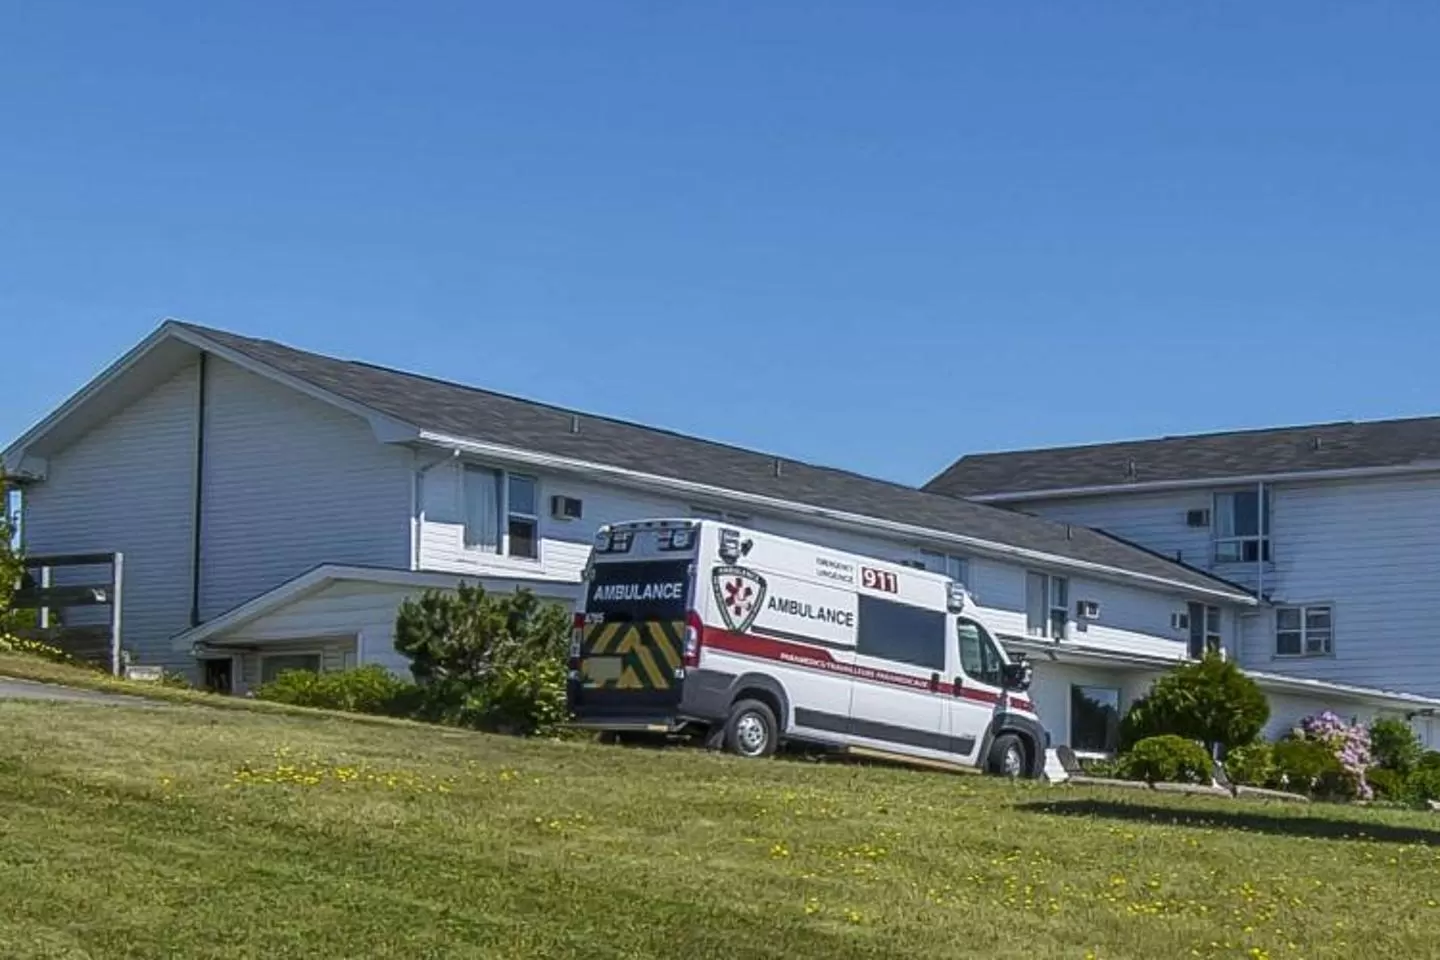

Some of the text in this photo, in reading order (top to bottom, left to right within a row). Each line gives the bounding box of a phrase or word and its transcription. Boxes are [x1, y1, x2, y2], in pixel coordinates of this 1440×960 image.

[593, 583, 683, 601] AMBULANCE
[864, 569, 896, 593] 911
[768, 596, 853, 627] AMBULANCE
